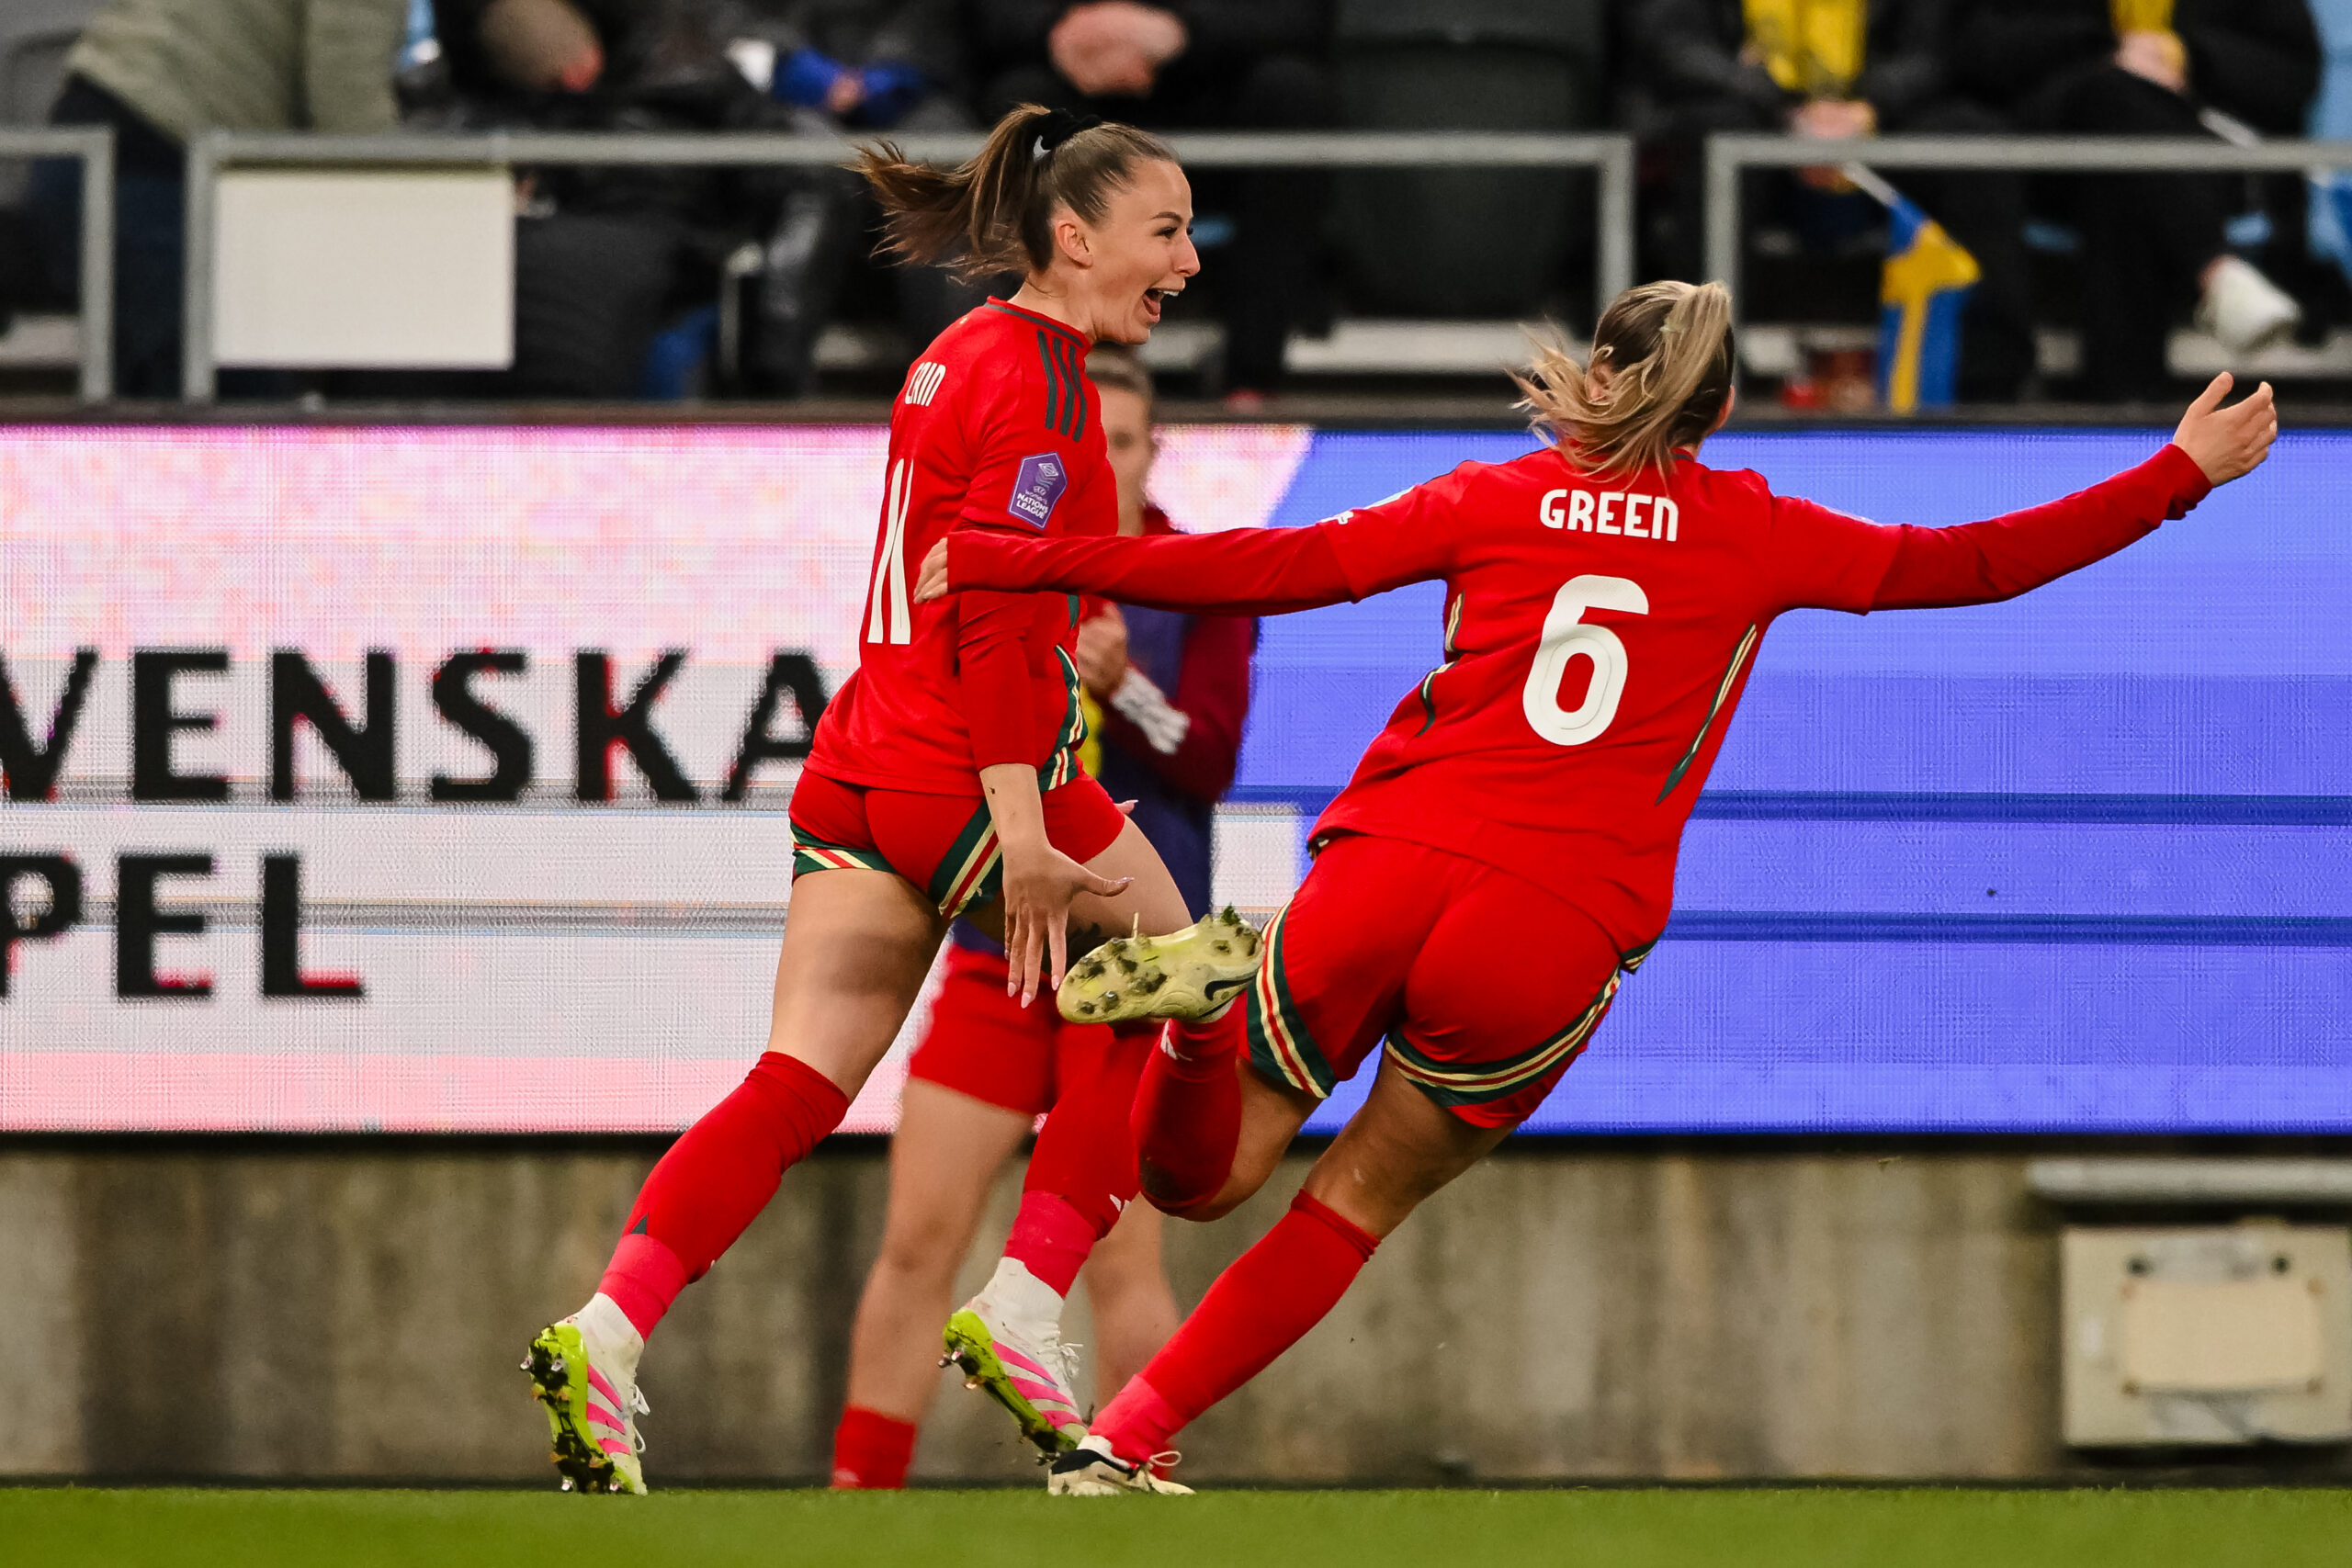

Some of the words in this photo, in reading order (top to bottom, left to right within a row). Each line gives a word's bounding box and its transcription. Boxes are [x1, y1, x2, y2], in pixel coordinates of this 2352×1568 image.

[866, 458, 913, 645] 11
[1016, 500, 1045, 519] LEAGUE
[1017, 492, 1048, 514] NATIONS
[1540, 489, 1679, 542] GREEN
[1522, 574, 1649, 745] 6
[0, 852, 365, 998] PEL
